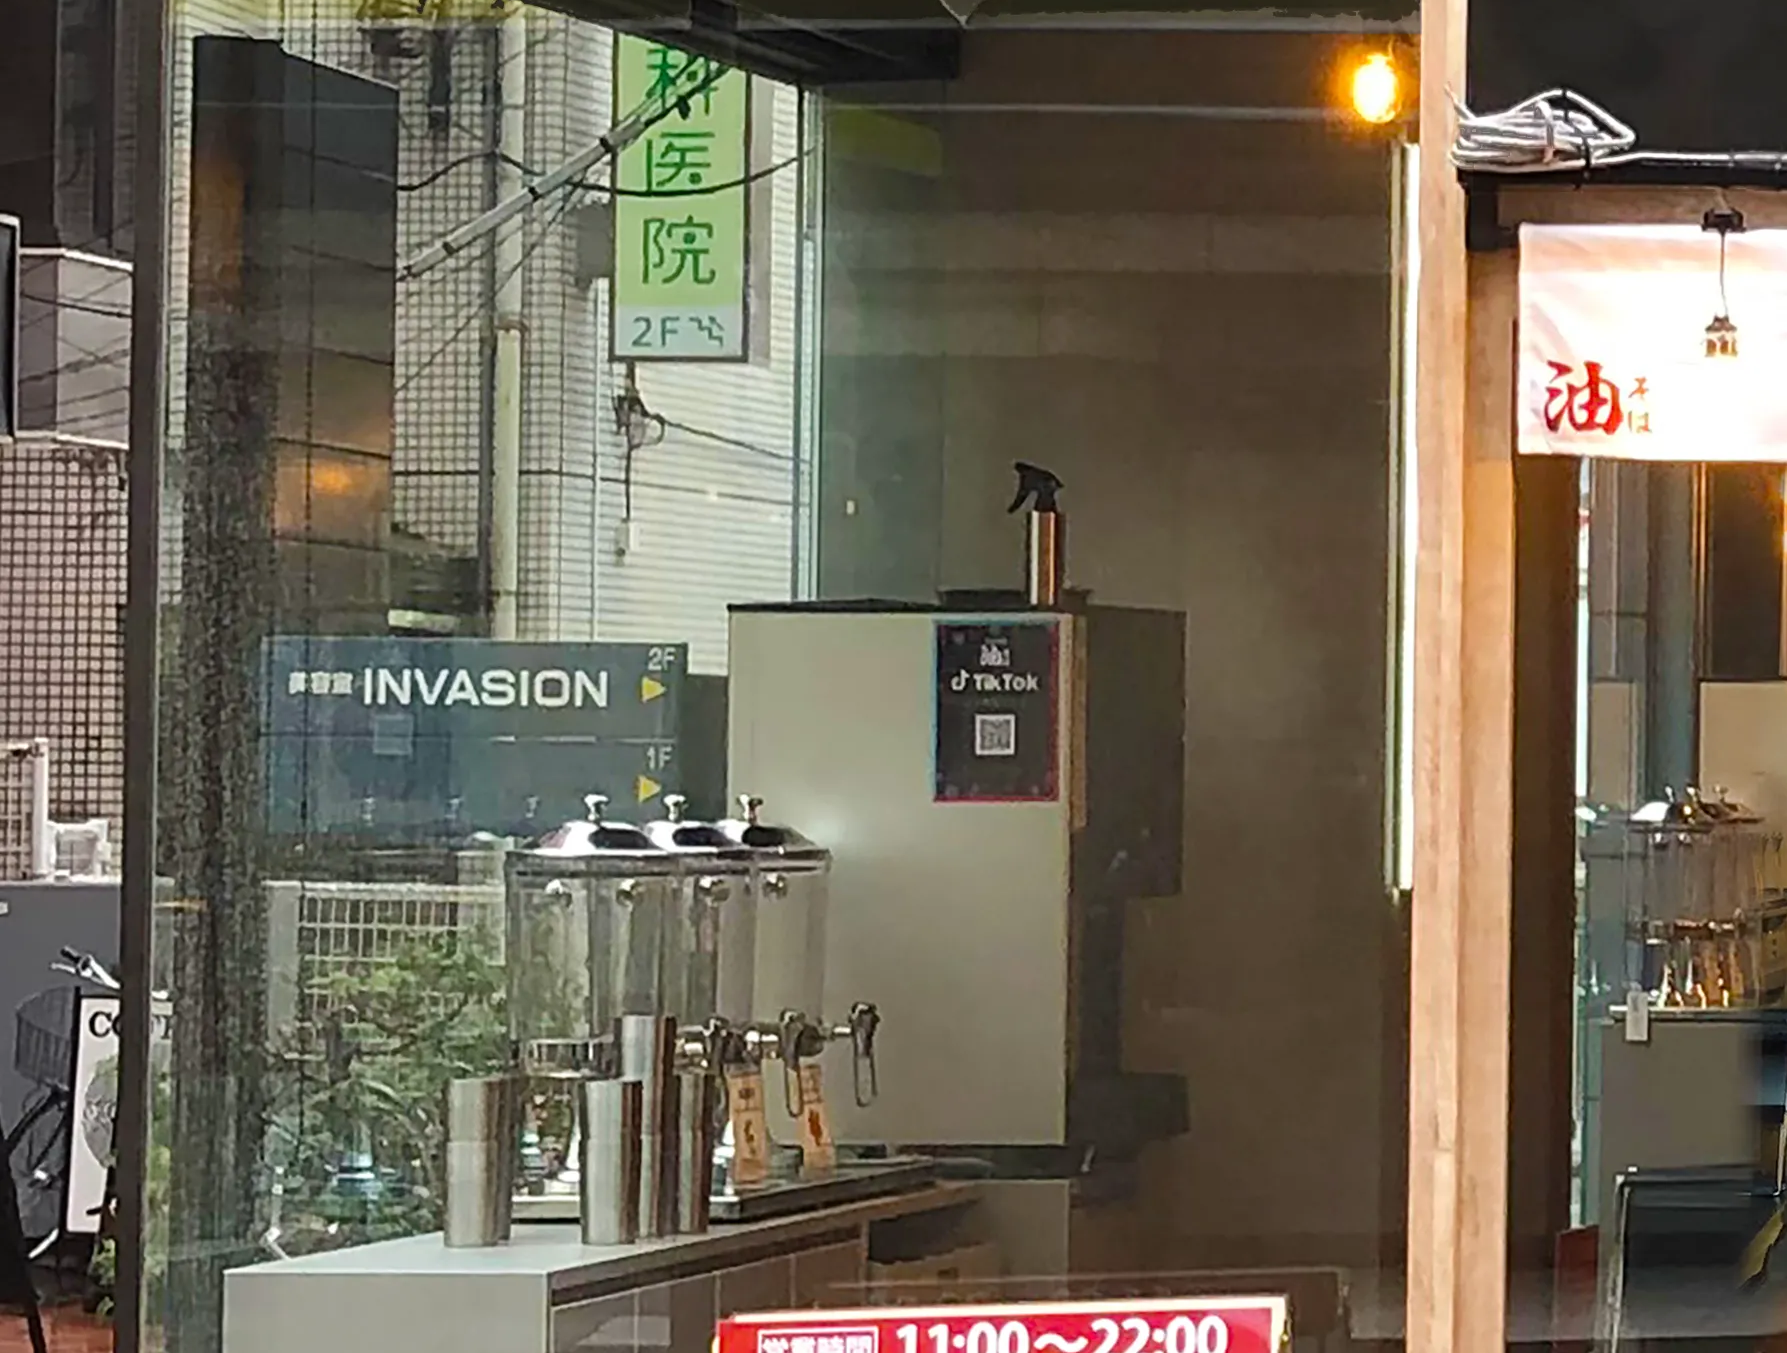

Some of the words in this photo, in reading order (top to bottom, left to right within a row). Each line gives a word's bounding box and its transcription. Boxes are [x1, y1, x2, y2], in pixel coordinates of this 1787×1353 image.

[632, 316, 681, 347] 2F
[363, 668, 609, 708] INVASION
[647, 648, 676, 671] 2F
[646, 747, 672, 769] 1F
